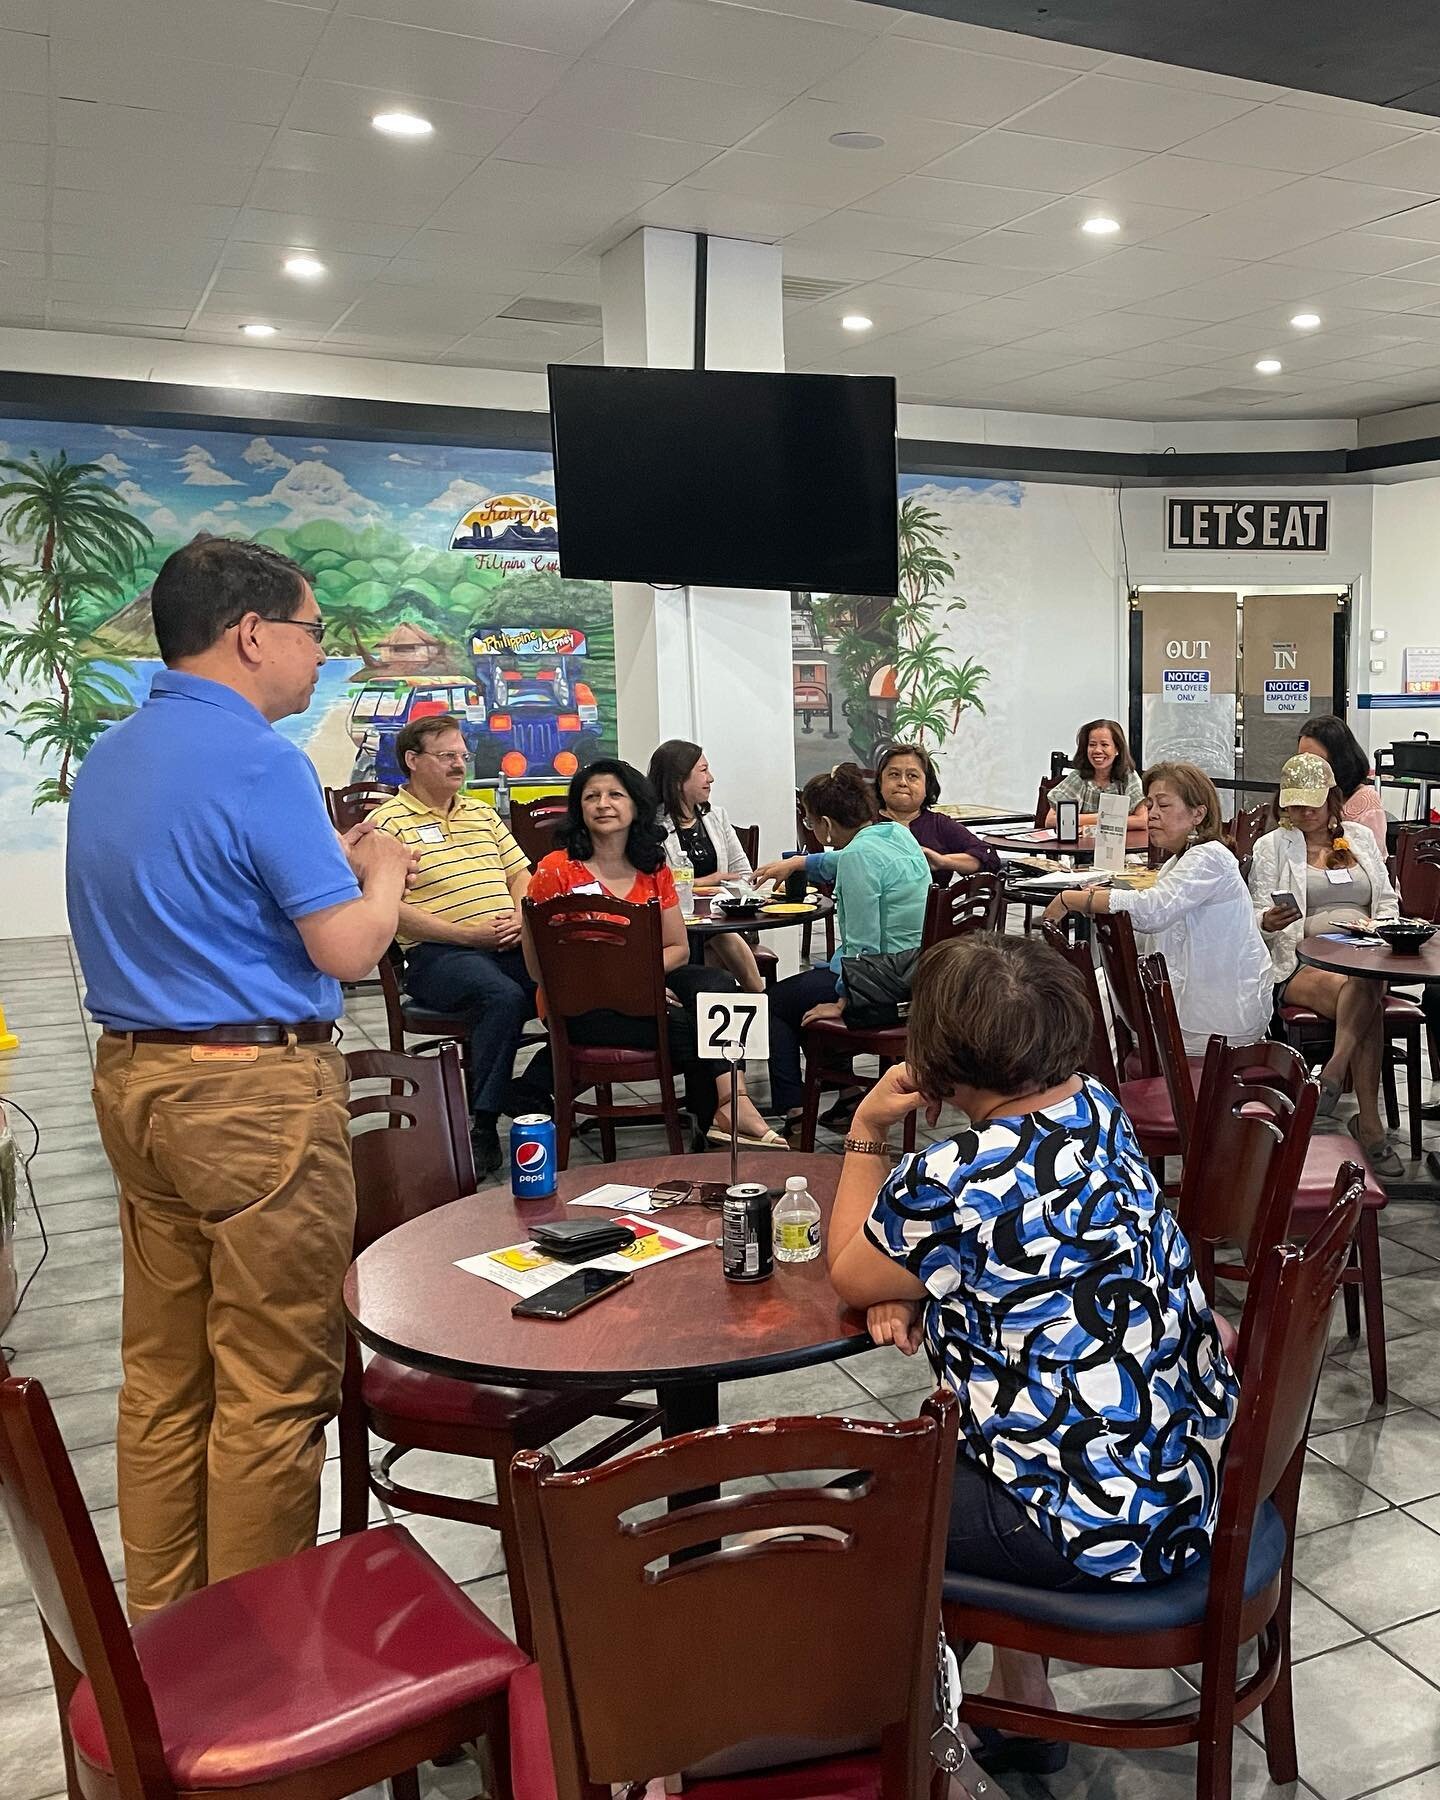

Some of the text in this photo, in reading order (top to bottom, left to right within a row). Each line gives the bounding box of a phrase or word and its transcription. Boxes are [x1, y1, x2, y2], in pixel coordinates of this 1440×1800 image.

[480, 501, 550, 521] Kain na
[1172, 503, 1324, 547] LET'S EAT
[474, 553, 560, 578] Filipino Cui
[483, 631, 574, 652] Philippine Jeepney
[1166, 640, 1211, 659] OUT
[1273, 651, 1298, 670] IN
[1168, 672, 1206, 682] NOTICE
[1268, 682, 1305, 691] NOTICE
[1165, 684, 1208, 692] EMPLOYEES
[707, 1004, 758, 1048] 27
[519, 1172, 545, 1183] pepsi
